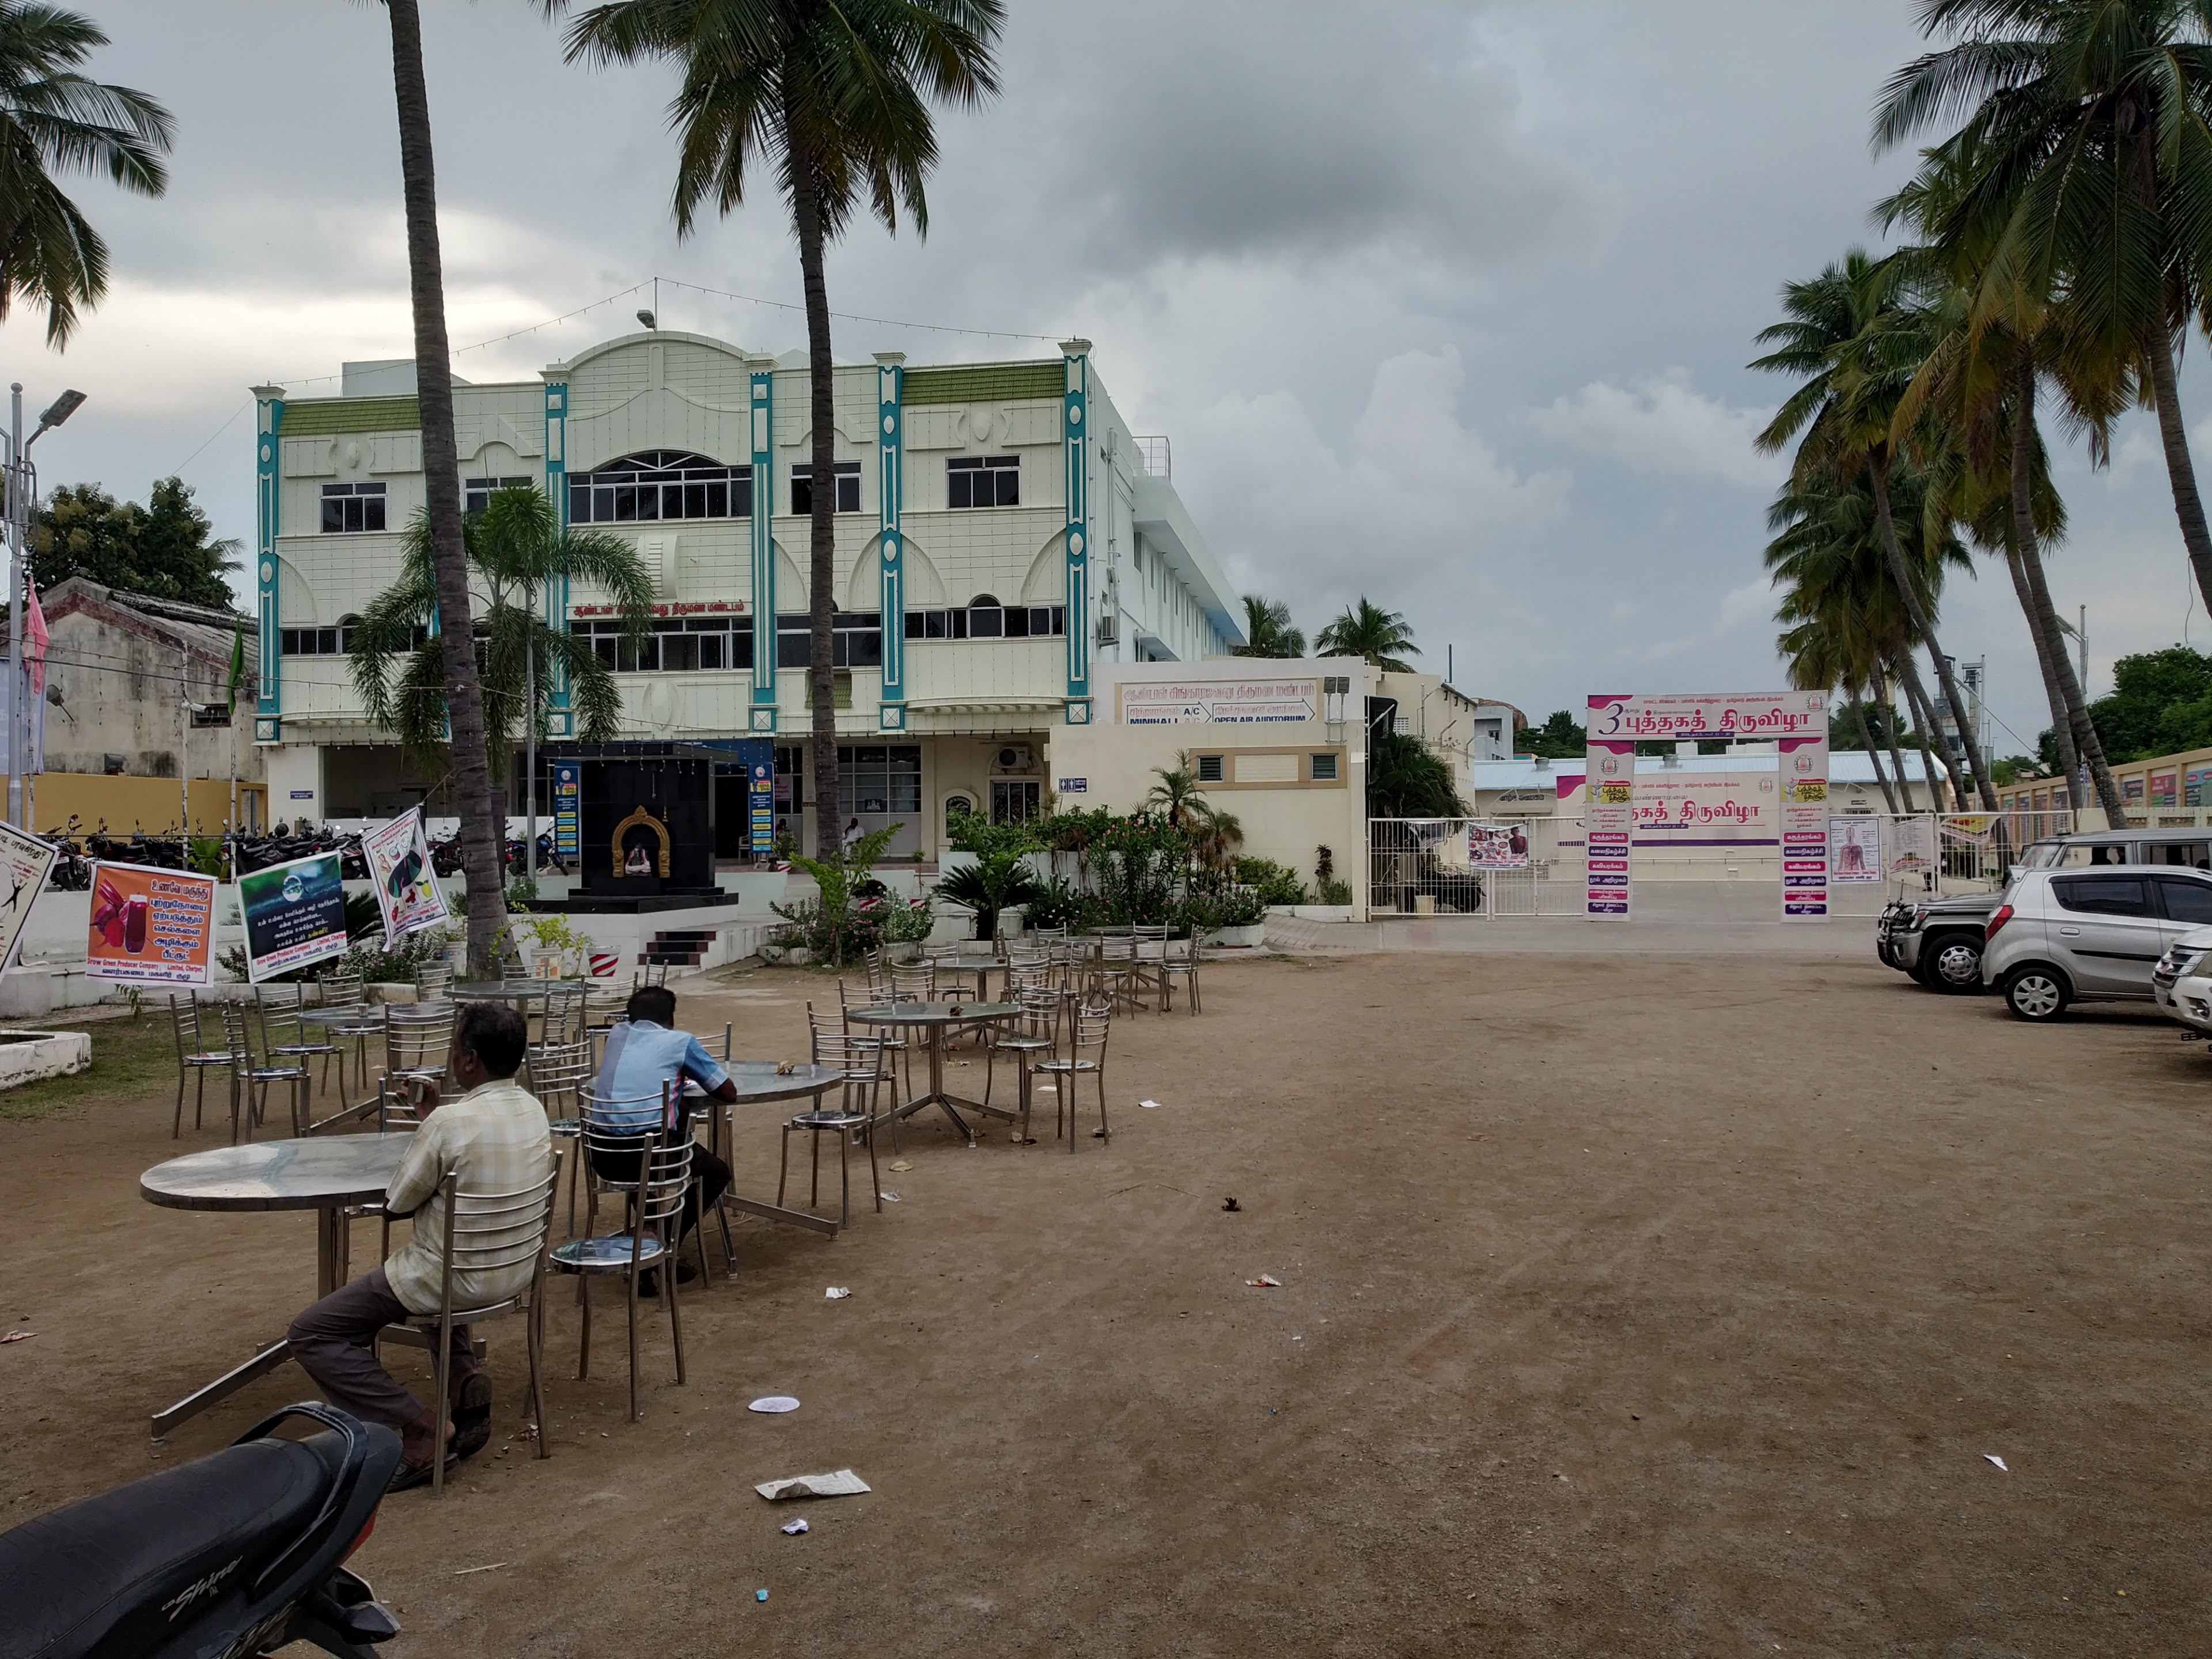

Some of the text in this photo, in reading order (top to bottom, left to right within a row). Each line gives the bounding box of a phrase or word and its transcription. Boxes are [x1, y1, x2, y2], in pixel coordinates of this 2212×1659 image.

[672, 602, 704, 616] திருமண
[707, 600, 744, 613] மண்டபம்
[1184, 707, 1200, 717] A/C
[1599, 703, 1624, 735] 3
[1627, 708, 1810, 733] புத்தகத் திருவிழா
[1680, 800, 1760, 824] திருவிழா
[151, 880, 209, 900] உணவே மருந்து
[150, 897, 207, 911] புற்றுநோயை
[153, 911, 203, 925] ஏற்படுத்தும்
[154, 925, 201, 935] செல்களை
[154, 938, 199, 948] அழிக்கும்
[88, 958, 101, 966] Grow
[118, 961, 138, 969] Producer
[139, 962, 160, 971] Company
[169, 1555, 243, 1623] Shine
